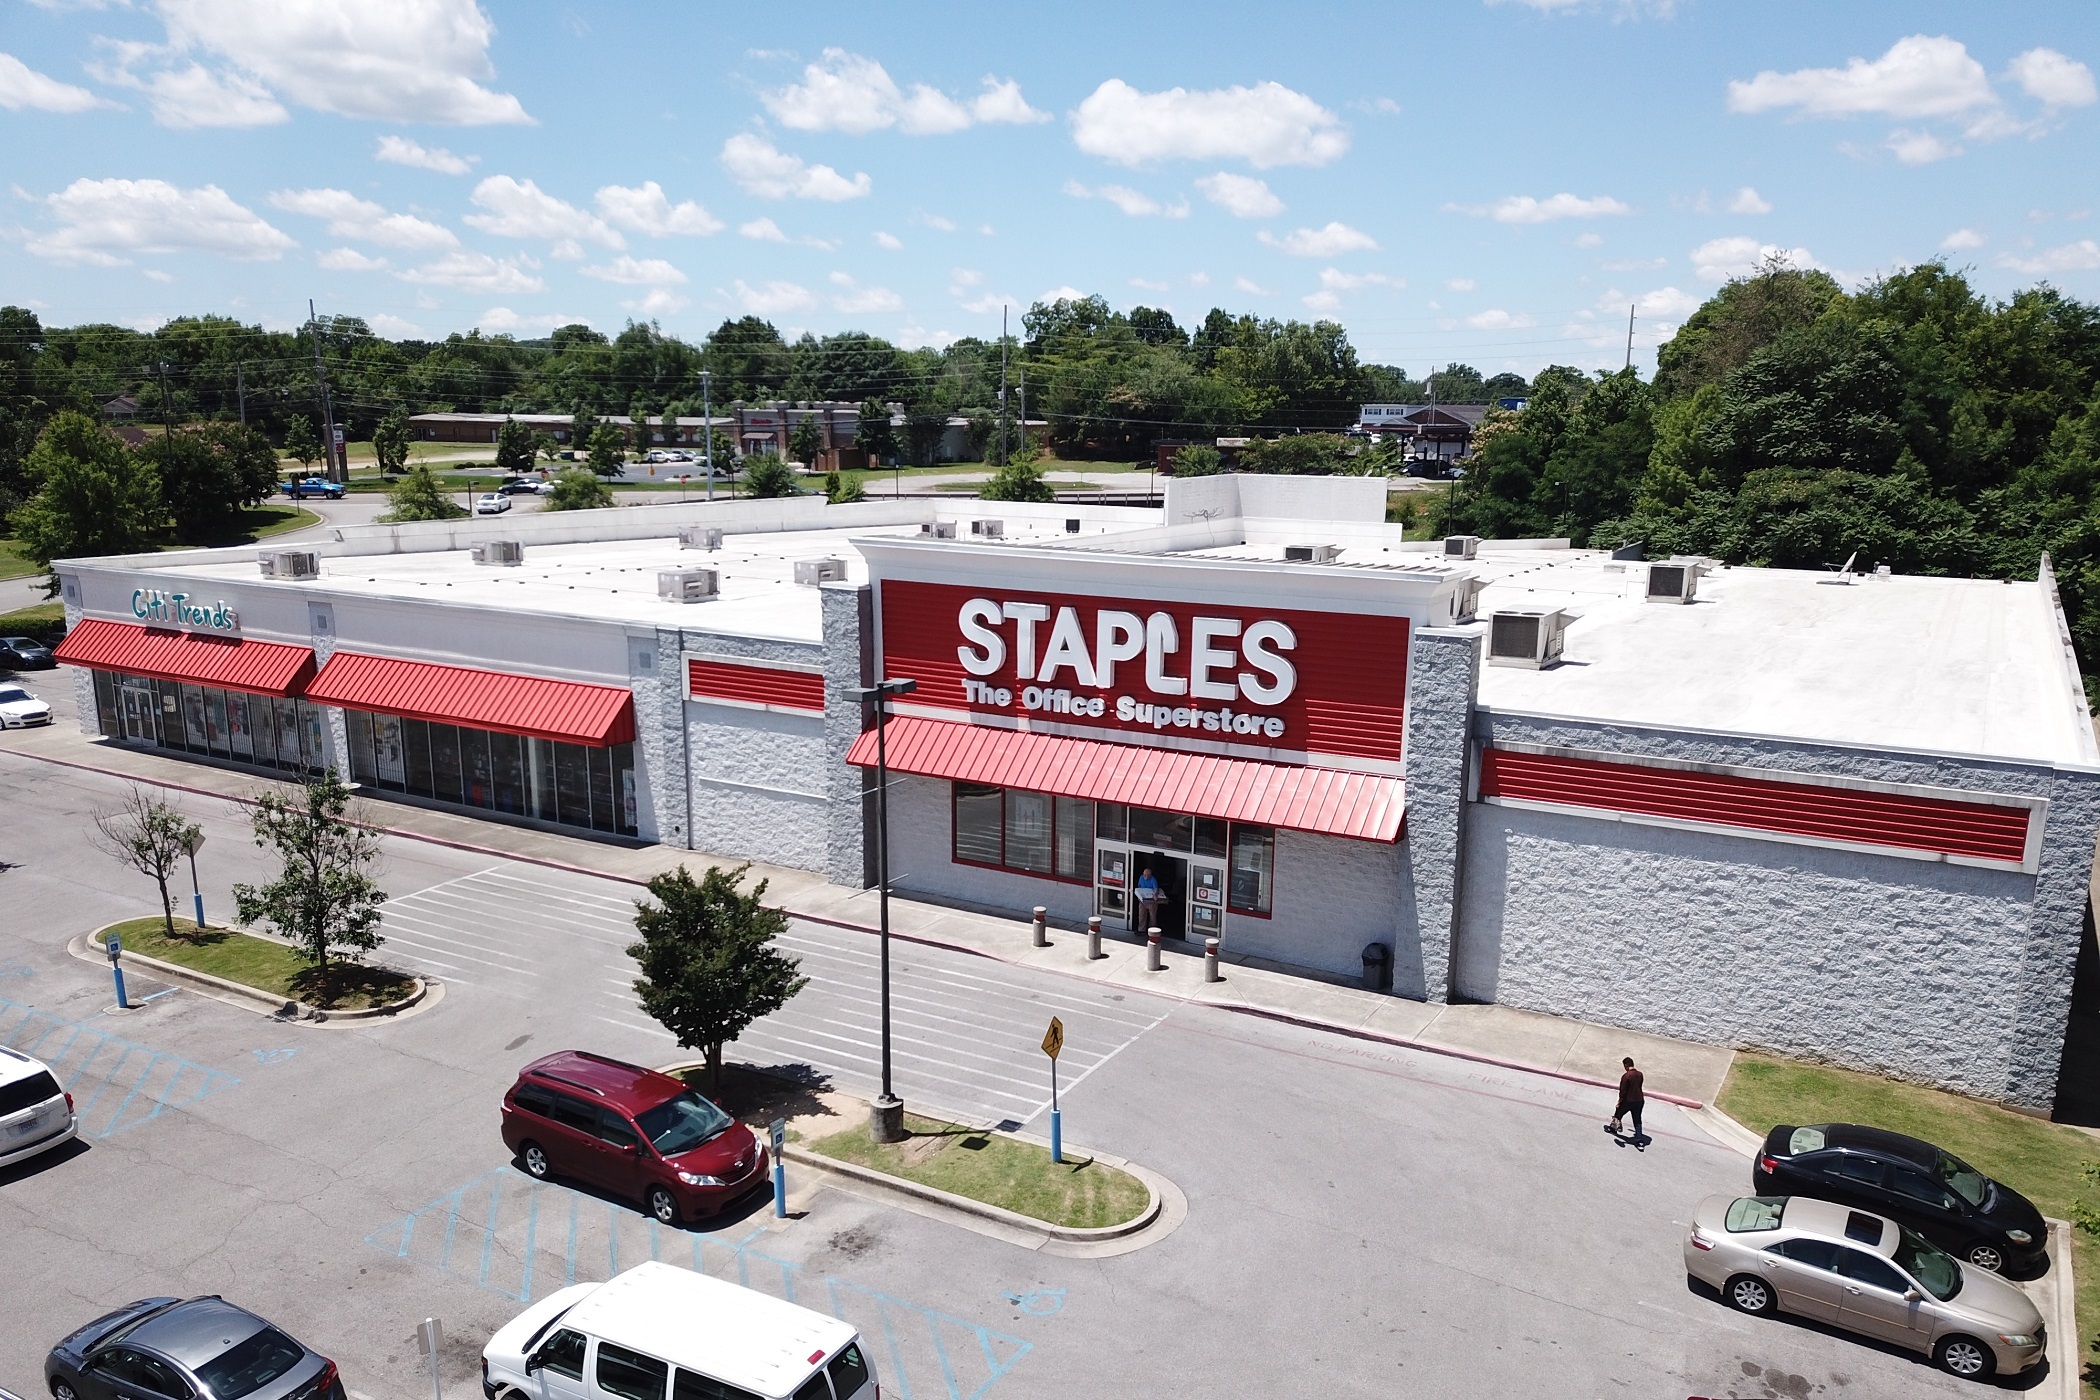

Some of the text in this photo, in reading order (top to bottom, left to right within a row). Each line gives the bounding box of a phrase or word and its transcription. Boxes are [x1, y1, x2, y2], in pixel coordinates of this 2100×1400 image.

[131, 589, 234, 631] Citi Trends
[957, 597, 1298, 706] STAPLES
[962, 678, 1287, 738] The Office Superstore
[1336, 1045, 1419, 1069] PARKING
